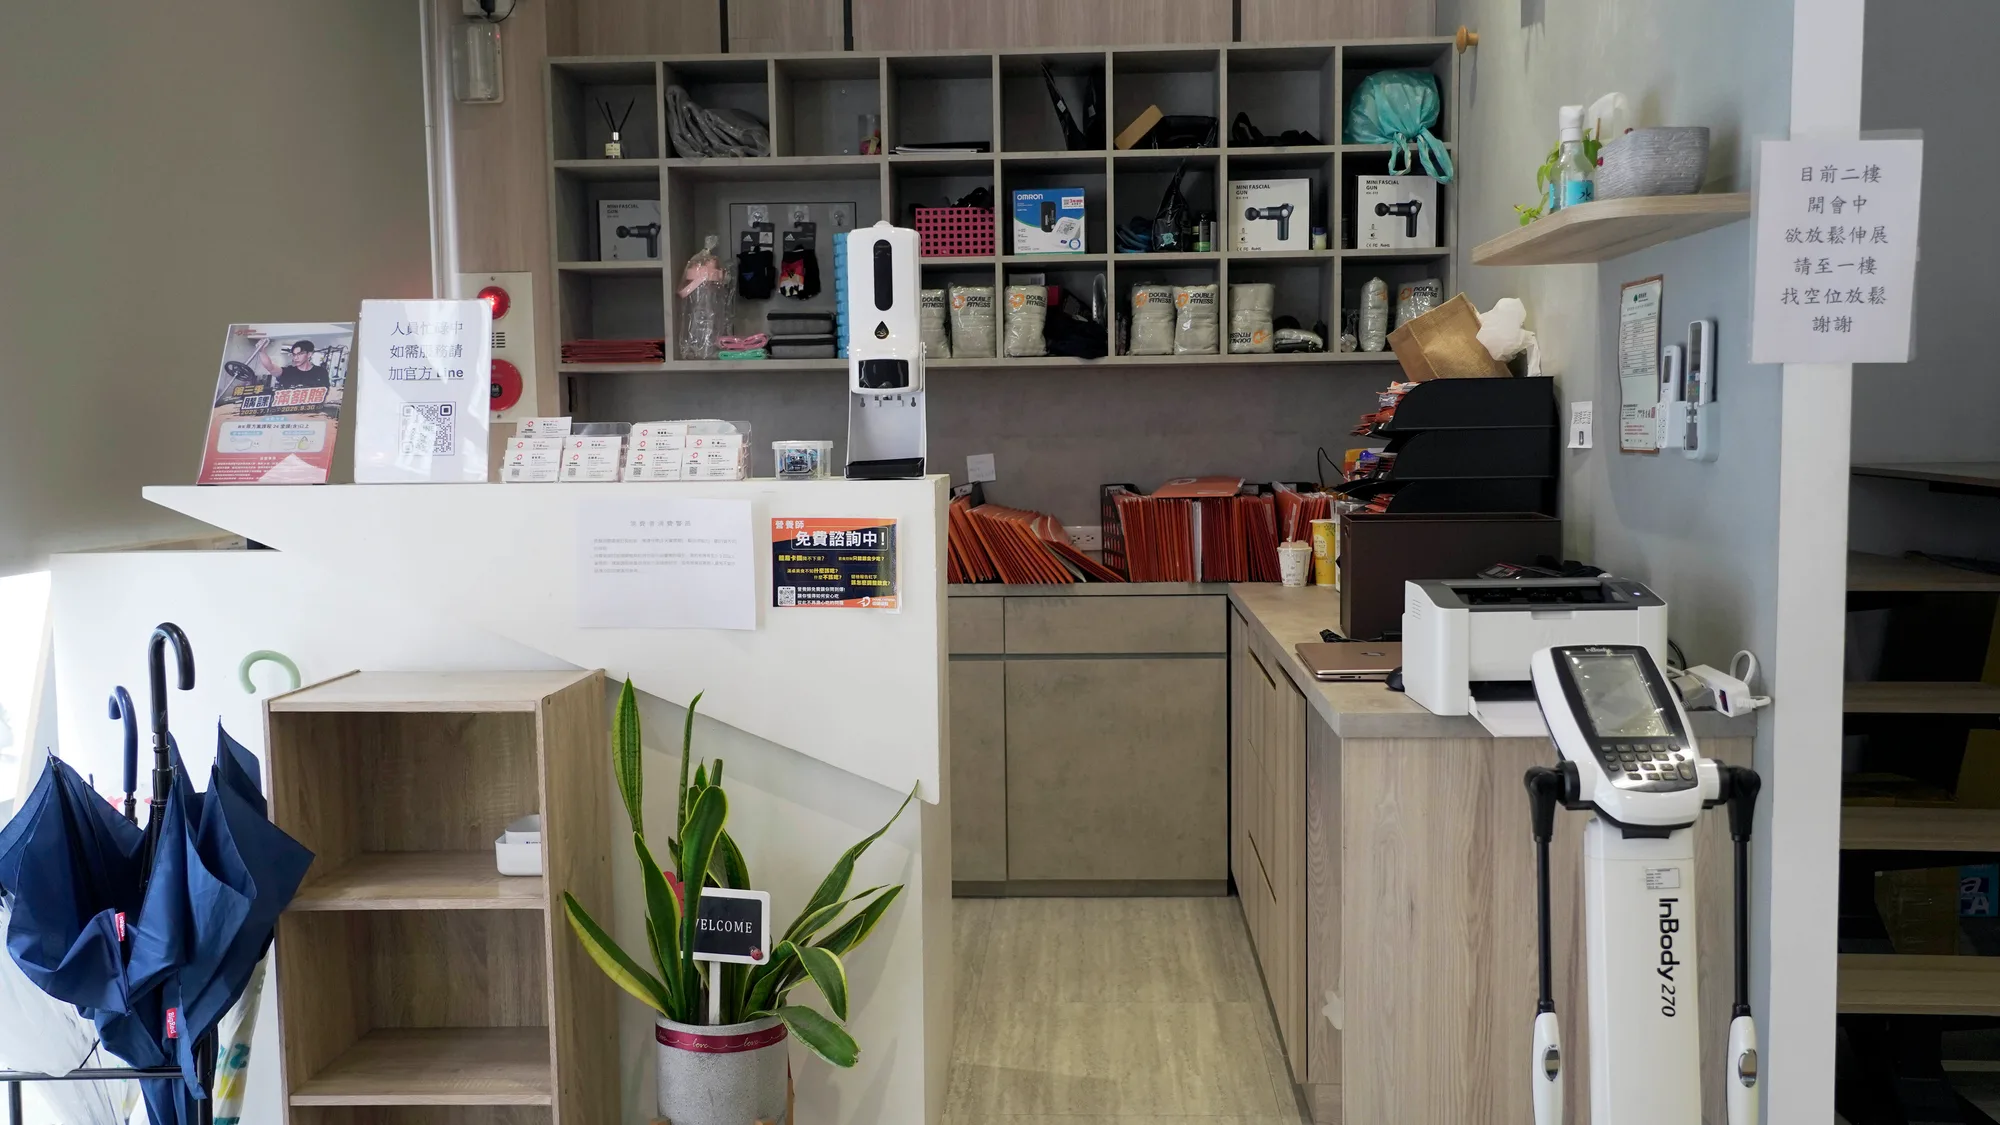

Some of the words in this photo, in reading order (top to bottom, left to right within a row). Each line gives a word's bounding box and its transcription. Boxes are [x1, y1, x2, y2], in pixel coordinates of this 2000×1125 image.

[1801, 164, 1882, 183] 目前二樓
[1016, 193, 1044, 201] OMRON
[1807, 195, 1867, 214] 開會中
[1785, 225, 1889, 245] 欲放鬆伸展
[1793, 256, 1878, 275] 請至一樓
[1780, 286, 1887, 305] 找空位放鬆
[1812, 315, 1853, 333] 謝謝
[390, 344, 463, 359] 如需服務請
[388, 366, 432, 381] 加官方
[273, 388, 327, 406] 滿額贈
[775, 520, 805, 529] 營養師
[795, 531, 886, 547] 免費諮詢中!
[1657, 898, 1680, 982] InBody
[1661, 983, 1676, 1017] 270
[692, 1037, 709, 1048] love
[743, 1035, 759, 1046] love
